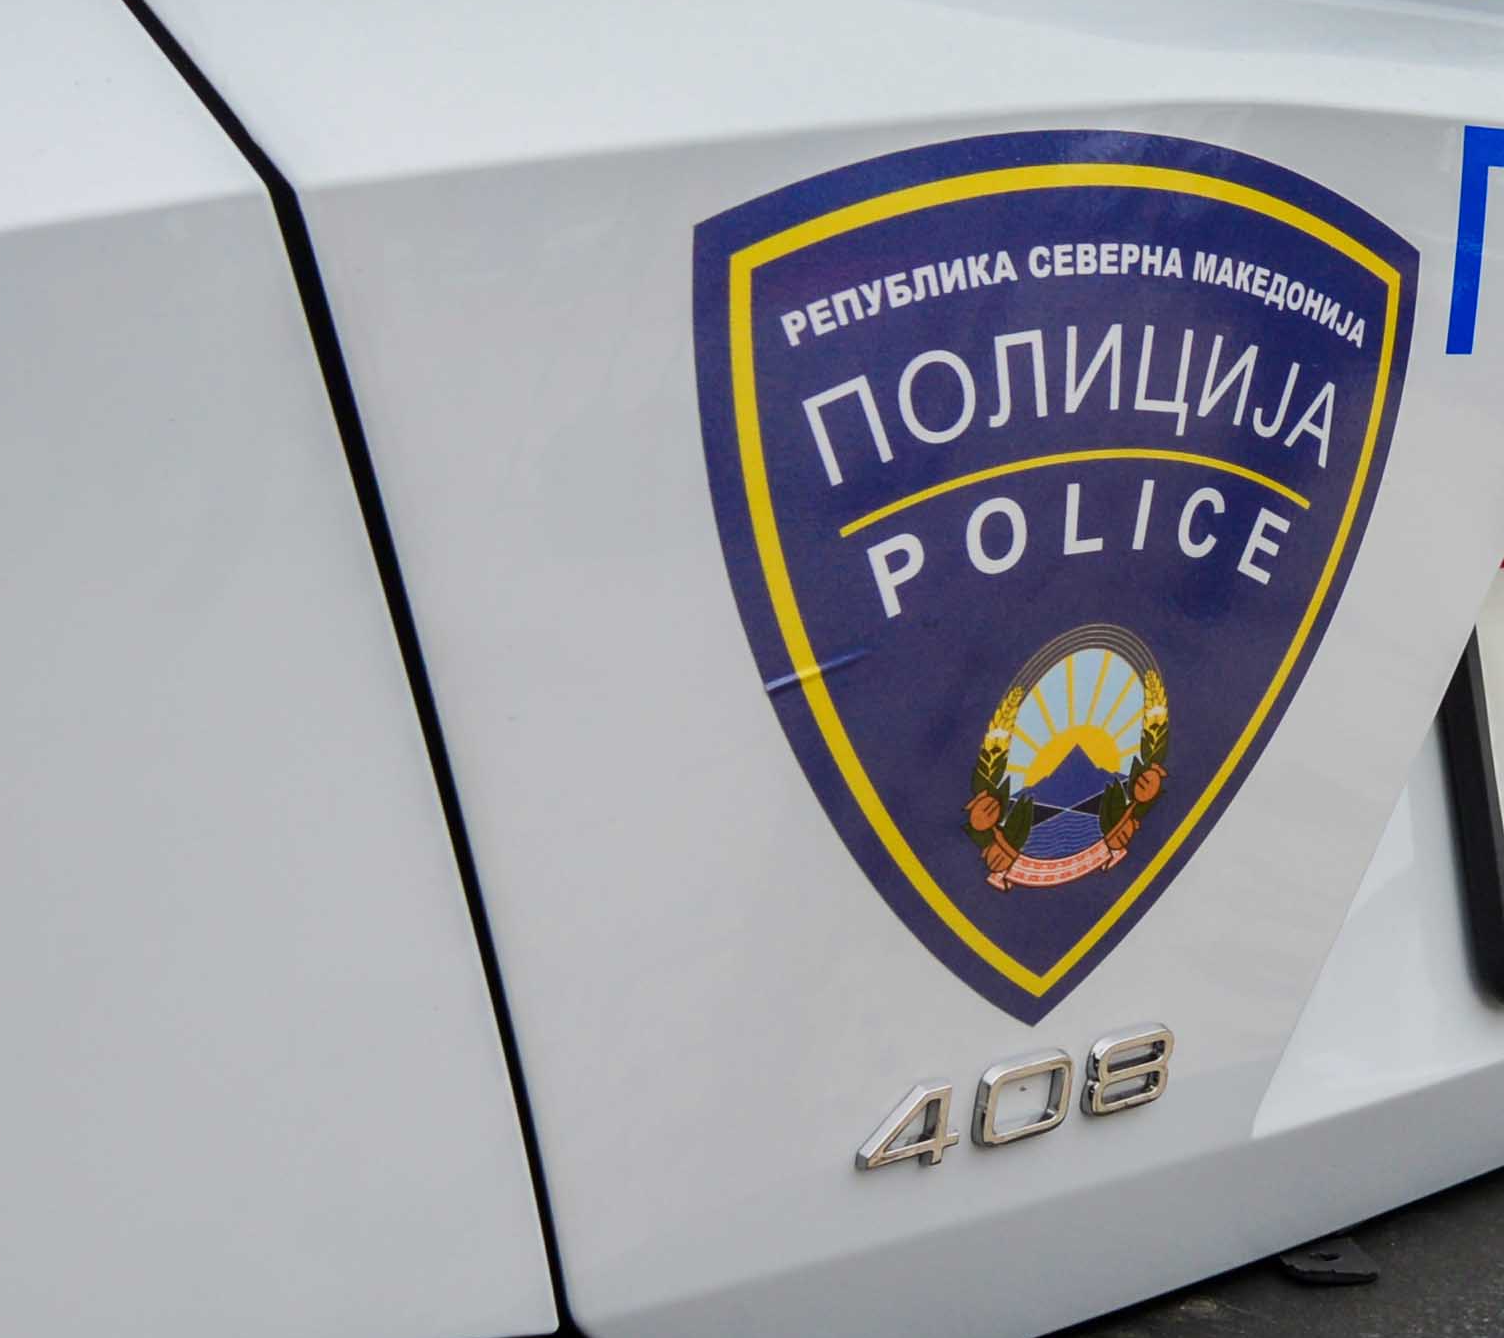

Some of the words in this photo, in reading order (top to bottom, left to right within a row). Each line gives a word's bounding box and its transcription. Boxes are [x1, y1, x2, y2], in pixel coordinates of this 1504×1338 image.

[780, 250, 1018, 347] РЕПУБЛИКА
[1027, 243, 1184, 281] СЕВЕРНА
[1192, 252, 1366, 349] МАКЕДОНИЈА
[802, 324, 1338, 487] ПОЛИЦИЈА
[866, 480, 1291, 618] POLICE
[854, 1022, 1175, 1170] 408
